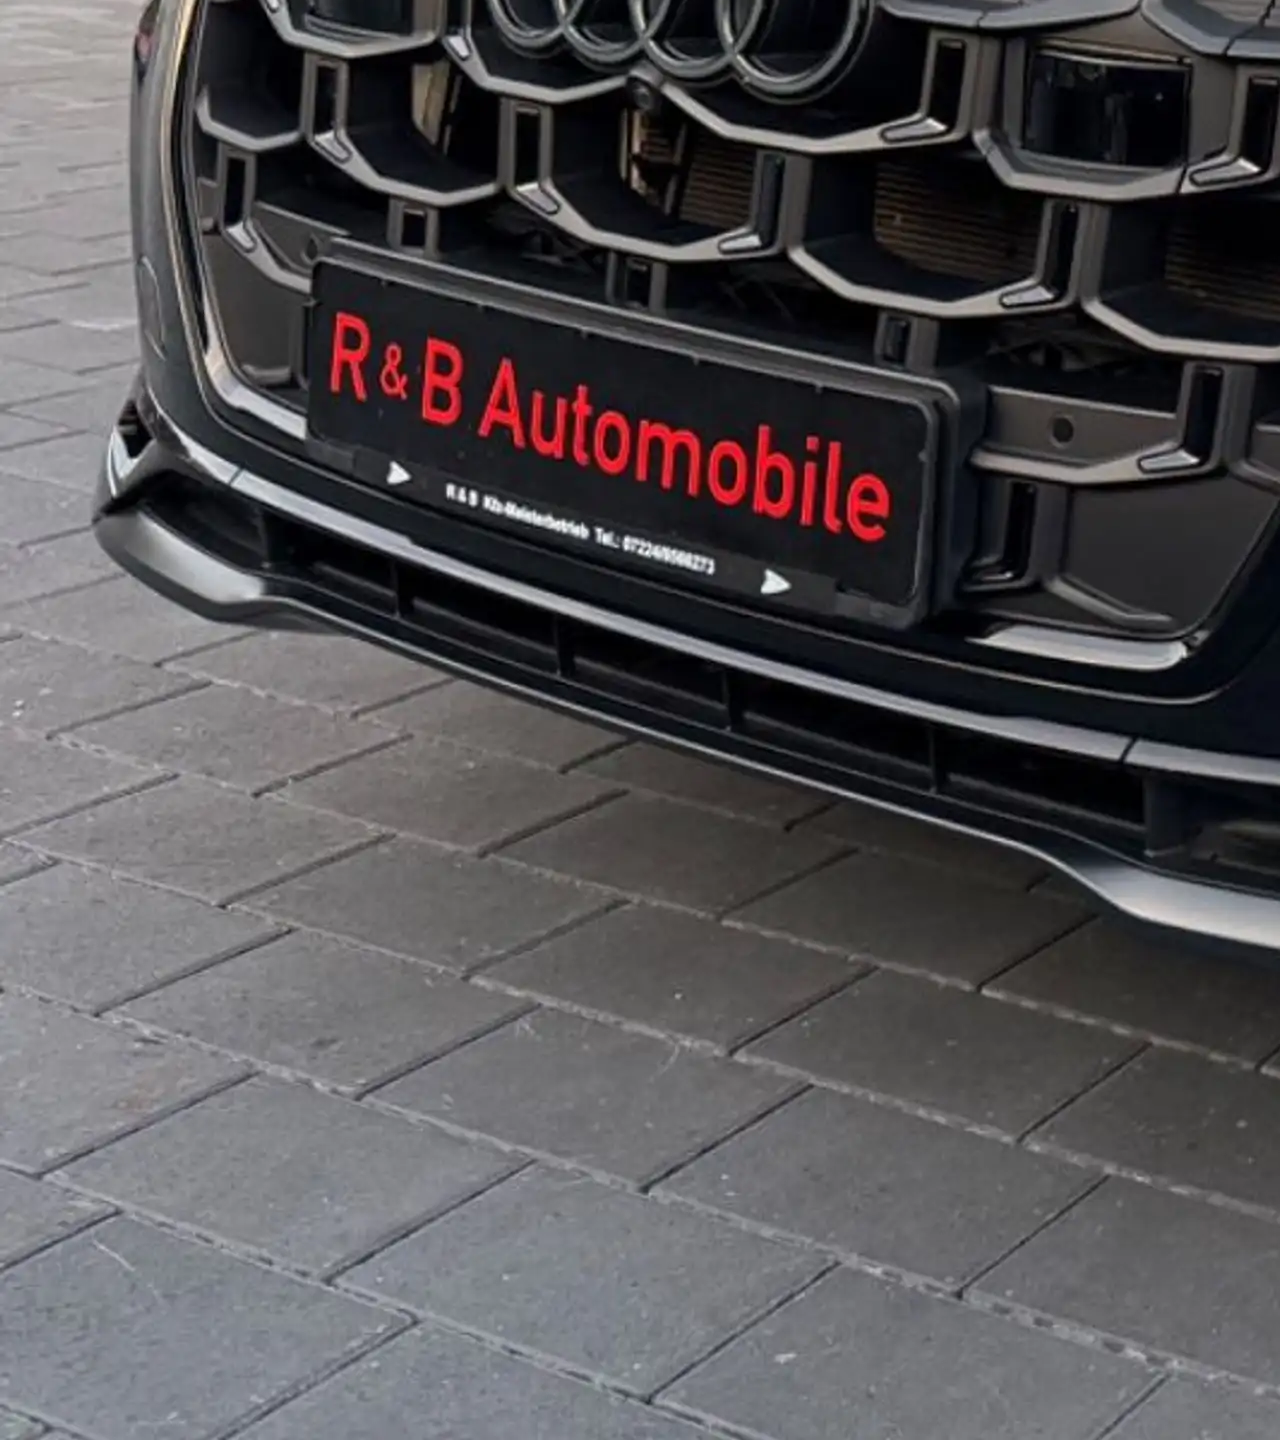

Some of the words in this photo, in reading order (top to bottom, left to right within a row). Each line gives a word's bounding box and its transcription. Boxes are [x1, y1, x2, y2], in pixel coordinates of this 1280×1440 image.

[329, 311, 371, 402] R
[380, 342, 408, 401] &
[420, 336, 464, 426] B
[477, 358, 891, 543] Automobile
